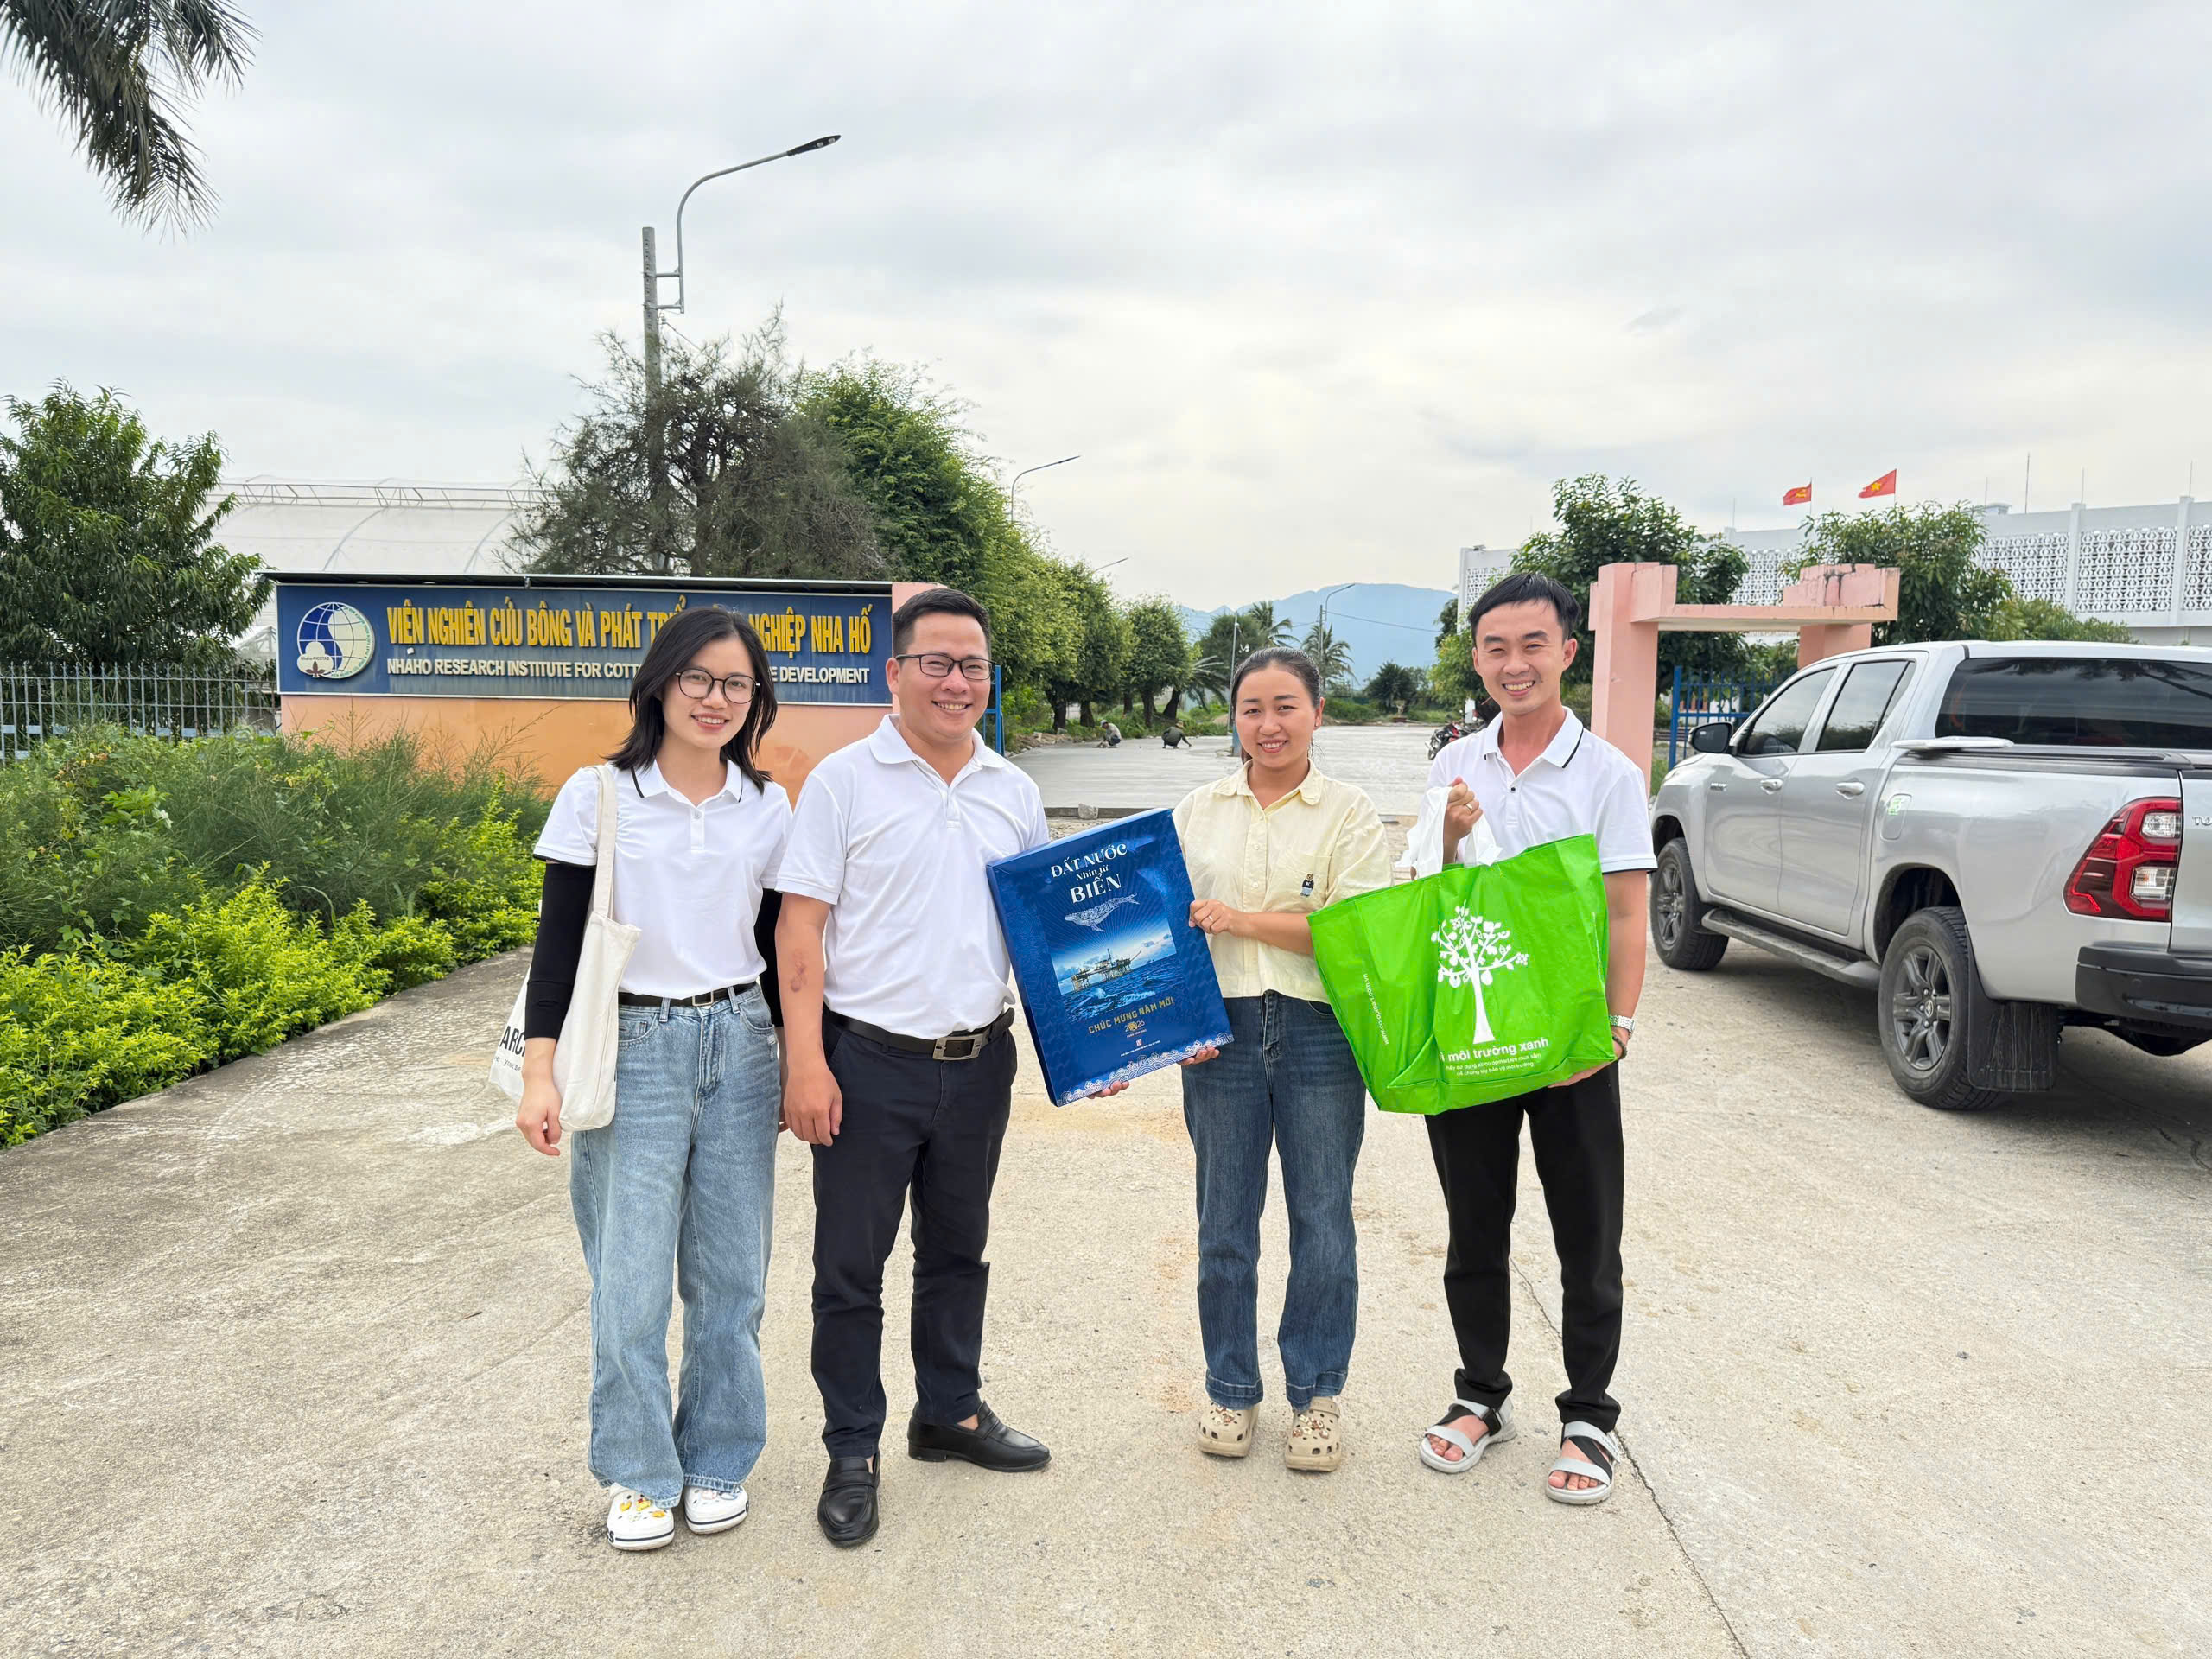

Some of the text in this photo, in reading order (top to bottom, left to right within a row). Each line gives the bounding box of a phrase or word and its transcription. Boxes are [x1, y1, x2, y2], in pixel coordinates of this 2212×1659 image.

[387, 598, 424, 654] VIỆN
[428, 600, 487, 645] NGHIÊN
[526, 601, 574, 647] BÔNG
[575, 602, 597, 648] VÀ
[600, 603, 644, 648] PHÁT
[810, 615, 845, 653] NHA
[849, 603, 873, 654] HỐ
[387, 659, 432, 675] NHAHO
[435, 659, 505, 676] RESEARCH
[507, 660, 572, 677] INSTITUTE
[574, 662, 602, 677] FOR
[604, 663, 643, 678] COTT
[779, 666, 870, 683] DEVELOPMENT
[1050, 843, 1128, 878] ĐẤT NƯỚC
[1070, 873, 1122, 903] BIỂN
[1518, 1037, 1549, 1052] xanh
